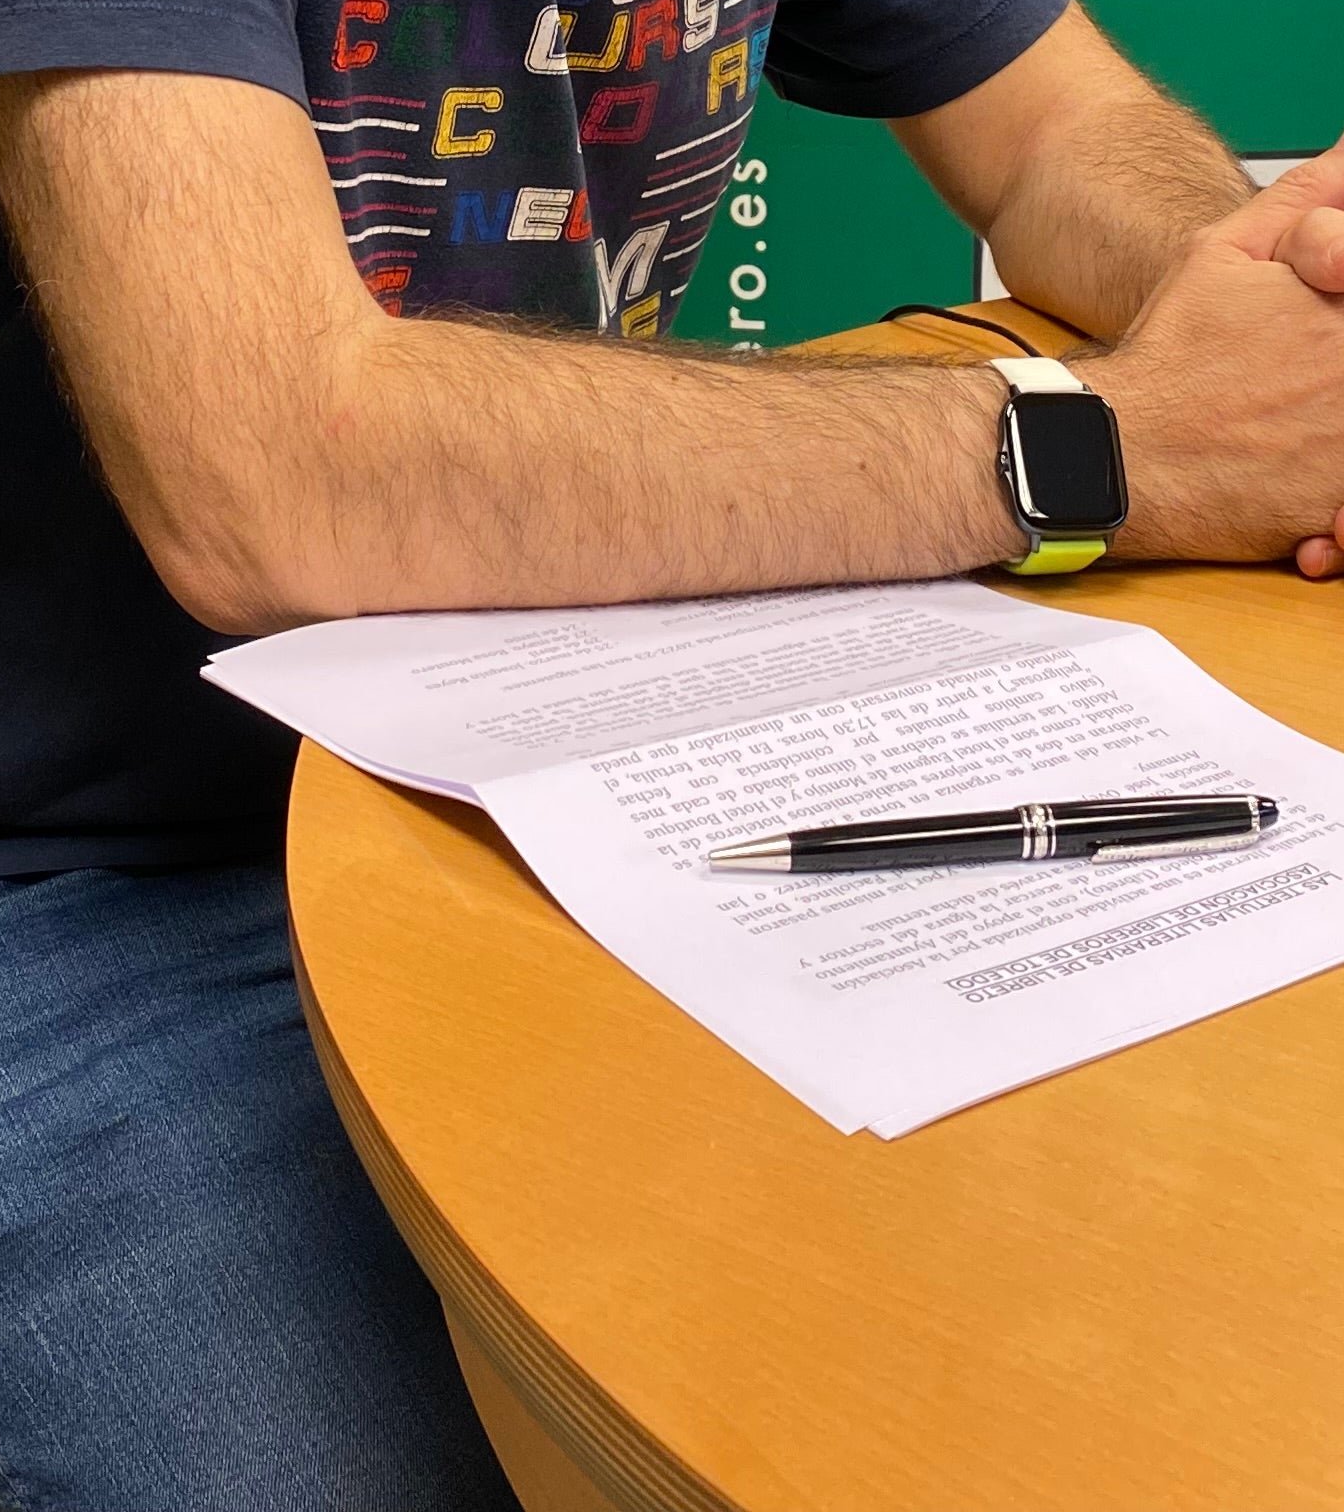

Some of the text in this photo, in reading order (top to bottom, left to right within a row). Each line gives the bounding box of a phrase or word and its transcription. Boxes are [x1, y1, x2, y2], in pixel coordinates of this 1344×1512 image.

[1015, 649, 1075, 668] invitado
[936, 667, 997, 688] invitada
[850, 683, 931, 712] conversará
[936, 687, 978, 707] partir
[816, 704, 844, 717] con
[880, 708, 906, 720] las
[909, 702, 928, 714] de
[1037, 704, 1067, 716] Las
[789, 712, 812, 723] un
[972, 712, 1035, 733] tertulias
[1041, 717, 1080, 733] como
[617, 674, 1104, 806] (salvo cambios puntuales por coincidencia con fechas
[688, 719, 783, 750] dinamizador
[950, 728, 969, 739] se
[1010, 728, 1039, 741] son
[1146, 727, 1169, 737] La
[748, 741, 773, 754] En
[880, 735, 945, 757] celebran
[952, 740, 995, 759] hotel
[993, 736, 1009, 748] el
[1102, 734, 1144, 750] visita
[647, 743, 679, 758] que
[697, 749, 741, 766] dicha
[1074, 746, 1098, 760] del
[590, 751, 642, 773] pueda
[804, 758, 856, 777] último
[860, 753, 876, 766] el
[889, 751, 953, 773] Eugenia
[1030, 754, 1070, 770] autor
[866, 768, 887, 780] de
[1005, 766, 1024, 776] se
[603, 778, 619, 792] el
[656, 716, 1149, 855] celebran en dos de los mejores establecimientos hoteleros de la
[743, 773, 799, 794] sábado
[803, 775, 867, 796] Montijo
[934, 773, 1000, 796] organiza
[715, 789, 736, 802] de
[769, 795, 786, 808] el
[908, 793, 929, 803] en
[670, 796, 709, 813] cada
[722, 800, 770, 821] Hotel
[859, 800, 905, 817] torno
[630, 806, 666, 822] mes
[644, 813, 722, 838] Boutique
[671, 858, 692, 870] se
[944, 863, 1324, 994] (ASOCIACIÓN DE LIBREROS DE TOLEDO)
[965, 872, 1342, 1002] LAS TERTULIAS LITERARIAS DE LIBRETO
